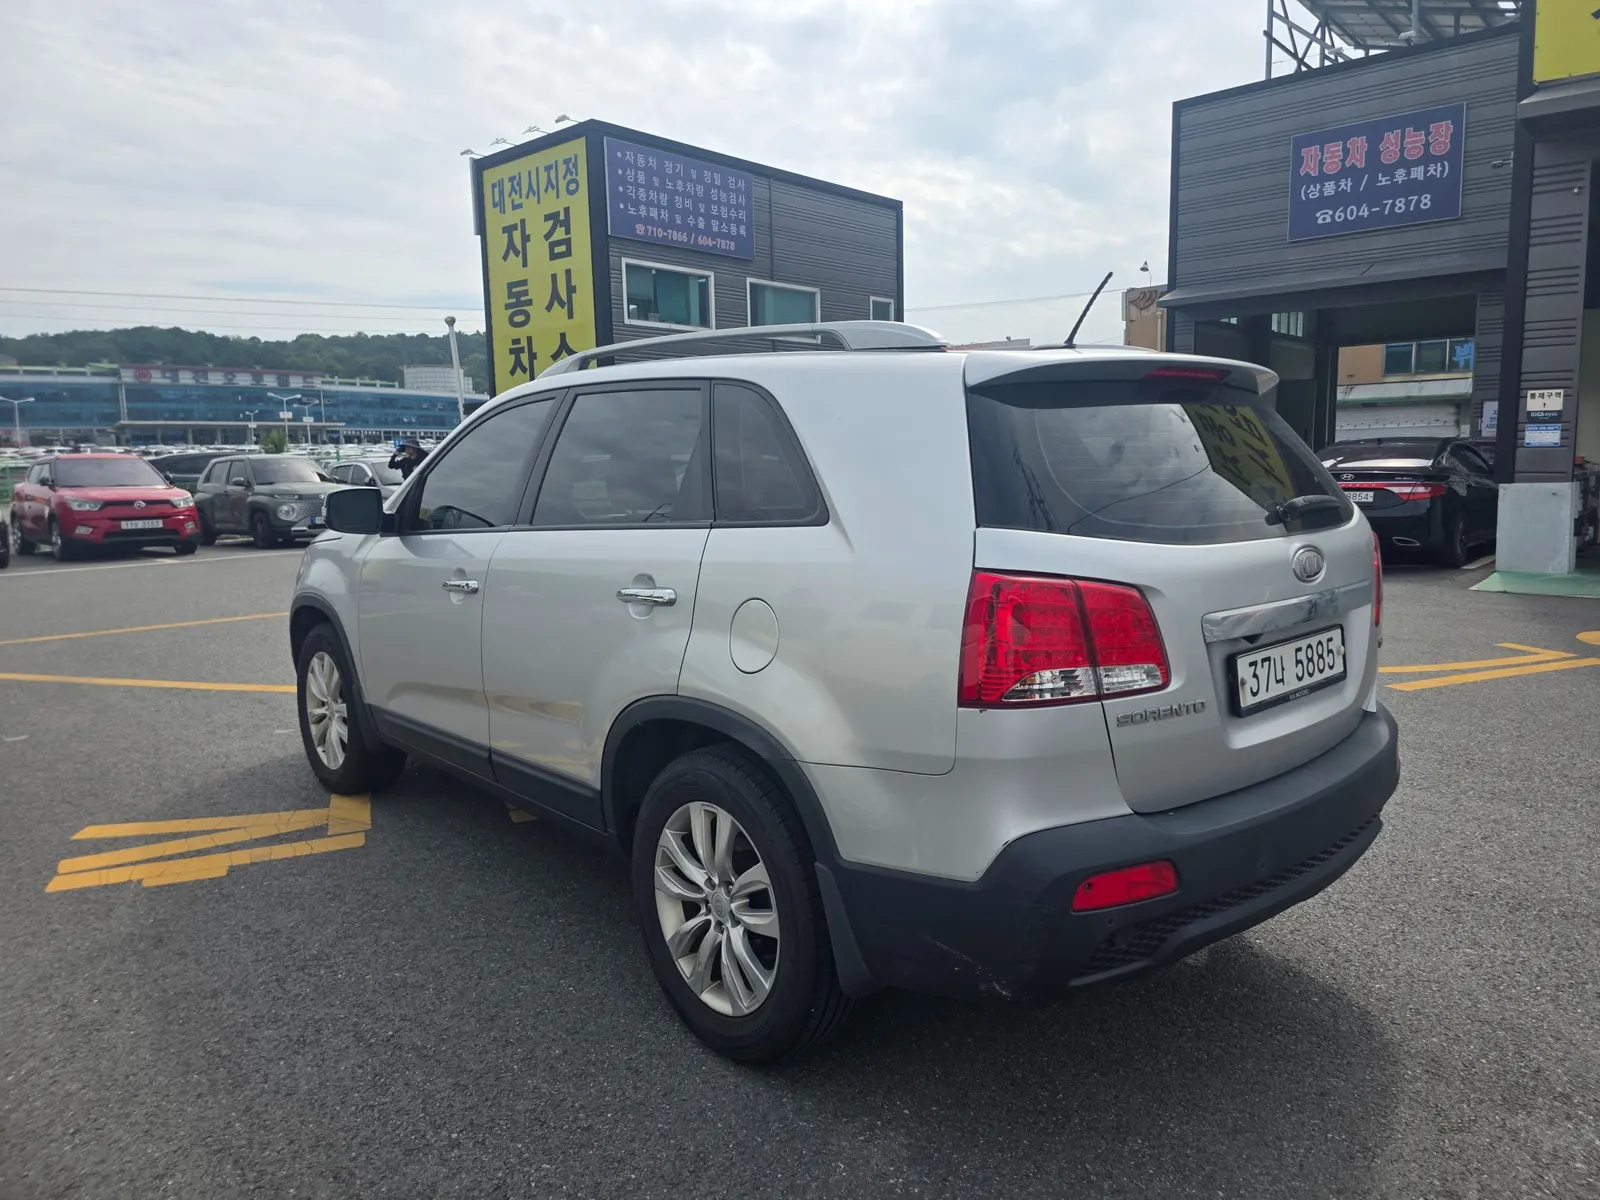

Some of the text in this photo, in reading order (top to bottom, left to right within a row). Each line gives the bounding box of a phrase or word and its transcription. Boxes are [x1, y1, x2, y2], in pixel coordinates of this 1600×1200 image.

[1300, 121, 1453, 177] 자동차 성능장
[491, 153, 581, 215] 대전시지정
[625, 151, 746, 191] 자동차 정기 및 정밀 검사
[625, 168, 746, 206] 상품 및 노후차량 성능검사
[1300, 174, 1353, 200] (상품차
[626, 185, 746, 222] 각종차량 정비 및 보험수리
[1334, 194, 1432, 223] 604-7878
[674, 214, 682, 225] 및
[687, 215, 705, 230] 수출
[710, 220, 747, 238] 말소등록
[697, 235, 736, 251] 604-7878
[501, 217, 537, 382] 자동차
[1248, 636, 1336, 698] 37나 5885
[1116, 698, 1207, 728] SORENTO
